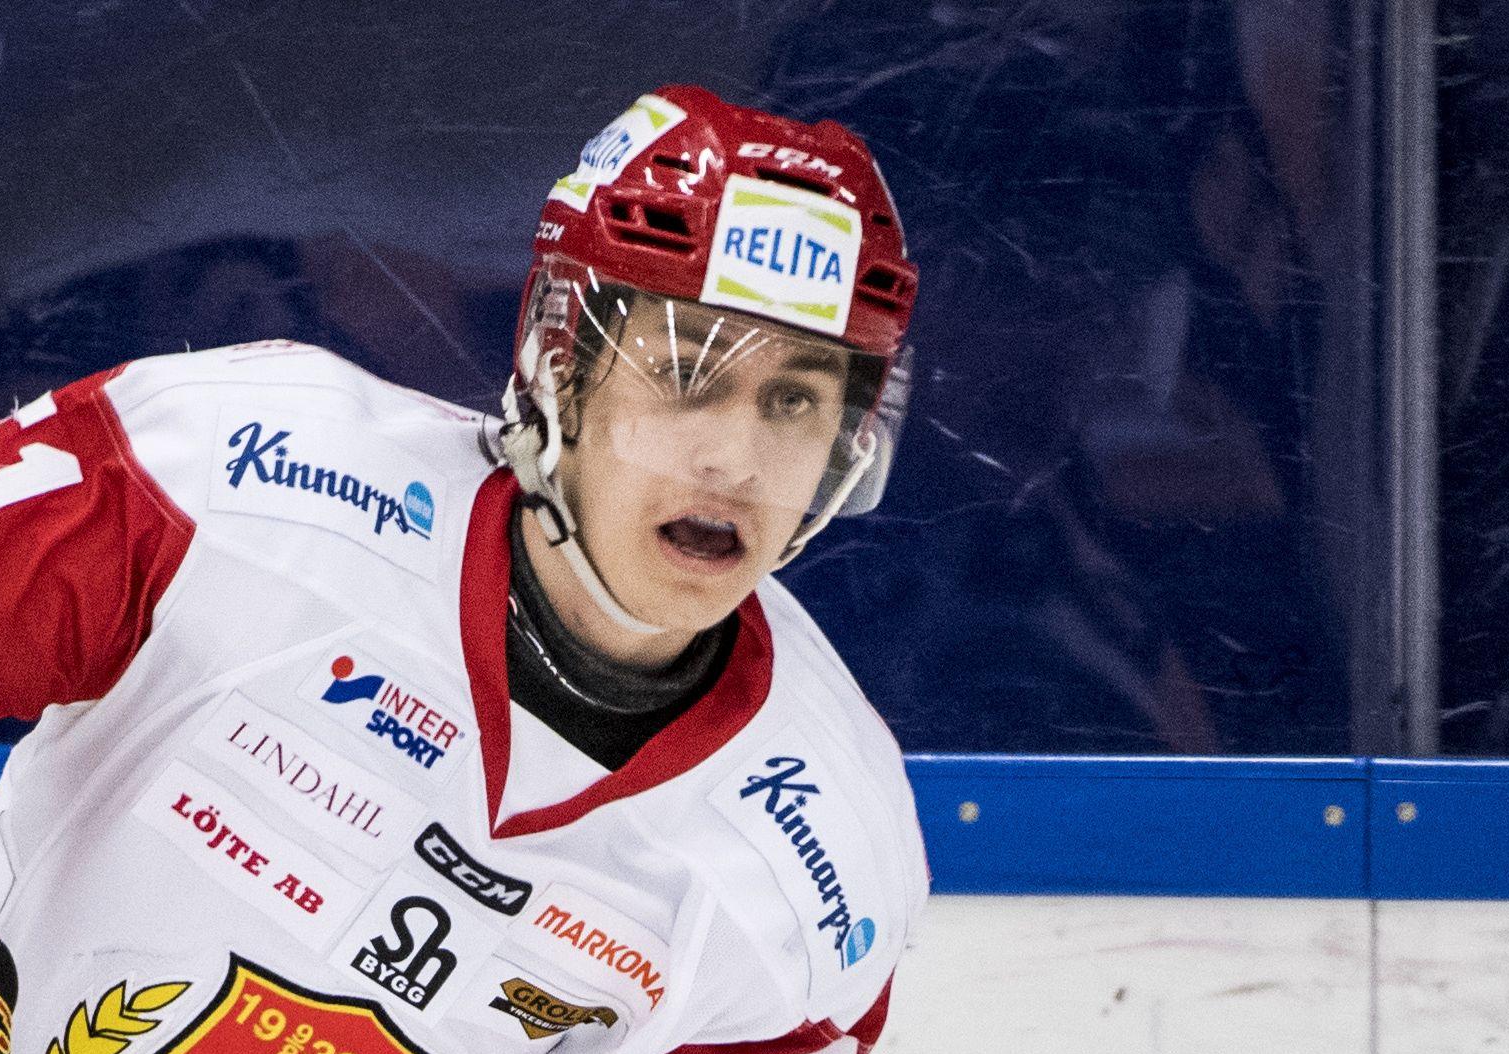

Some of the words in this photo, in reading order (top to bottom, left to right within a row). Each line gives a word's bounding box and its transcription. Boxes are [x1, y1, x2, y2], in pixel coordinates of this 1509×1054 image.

[723, 226, 842, 284] RELITA
[226, 421, 410, 535] Kinnarps
[365, 708, 445, 769] SPORT
[378, 682, 459, 750] INTER
[227, 721, 385, 839] LINDAHL
[171, 793, 270, 878] LÖJTE
[273, 872, 326, 915] AB
[423, 834, 528, 908] CCM
[739, 756, 852, 951] Kinnarps
[358, 953, 426, 1005] BYGG
[368, 895, 459, 987] Sh
[533, 904, 667, 1012] MARKONA
